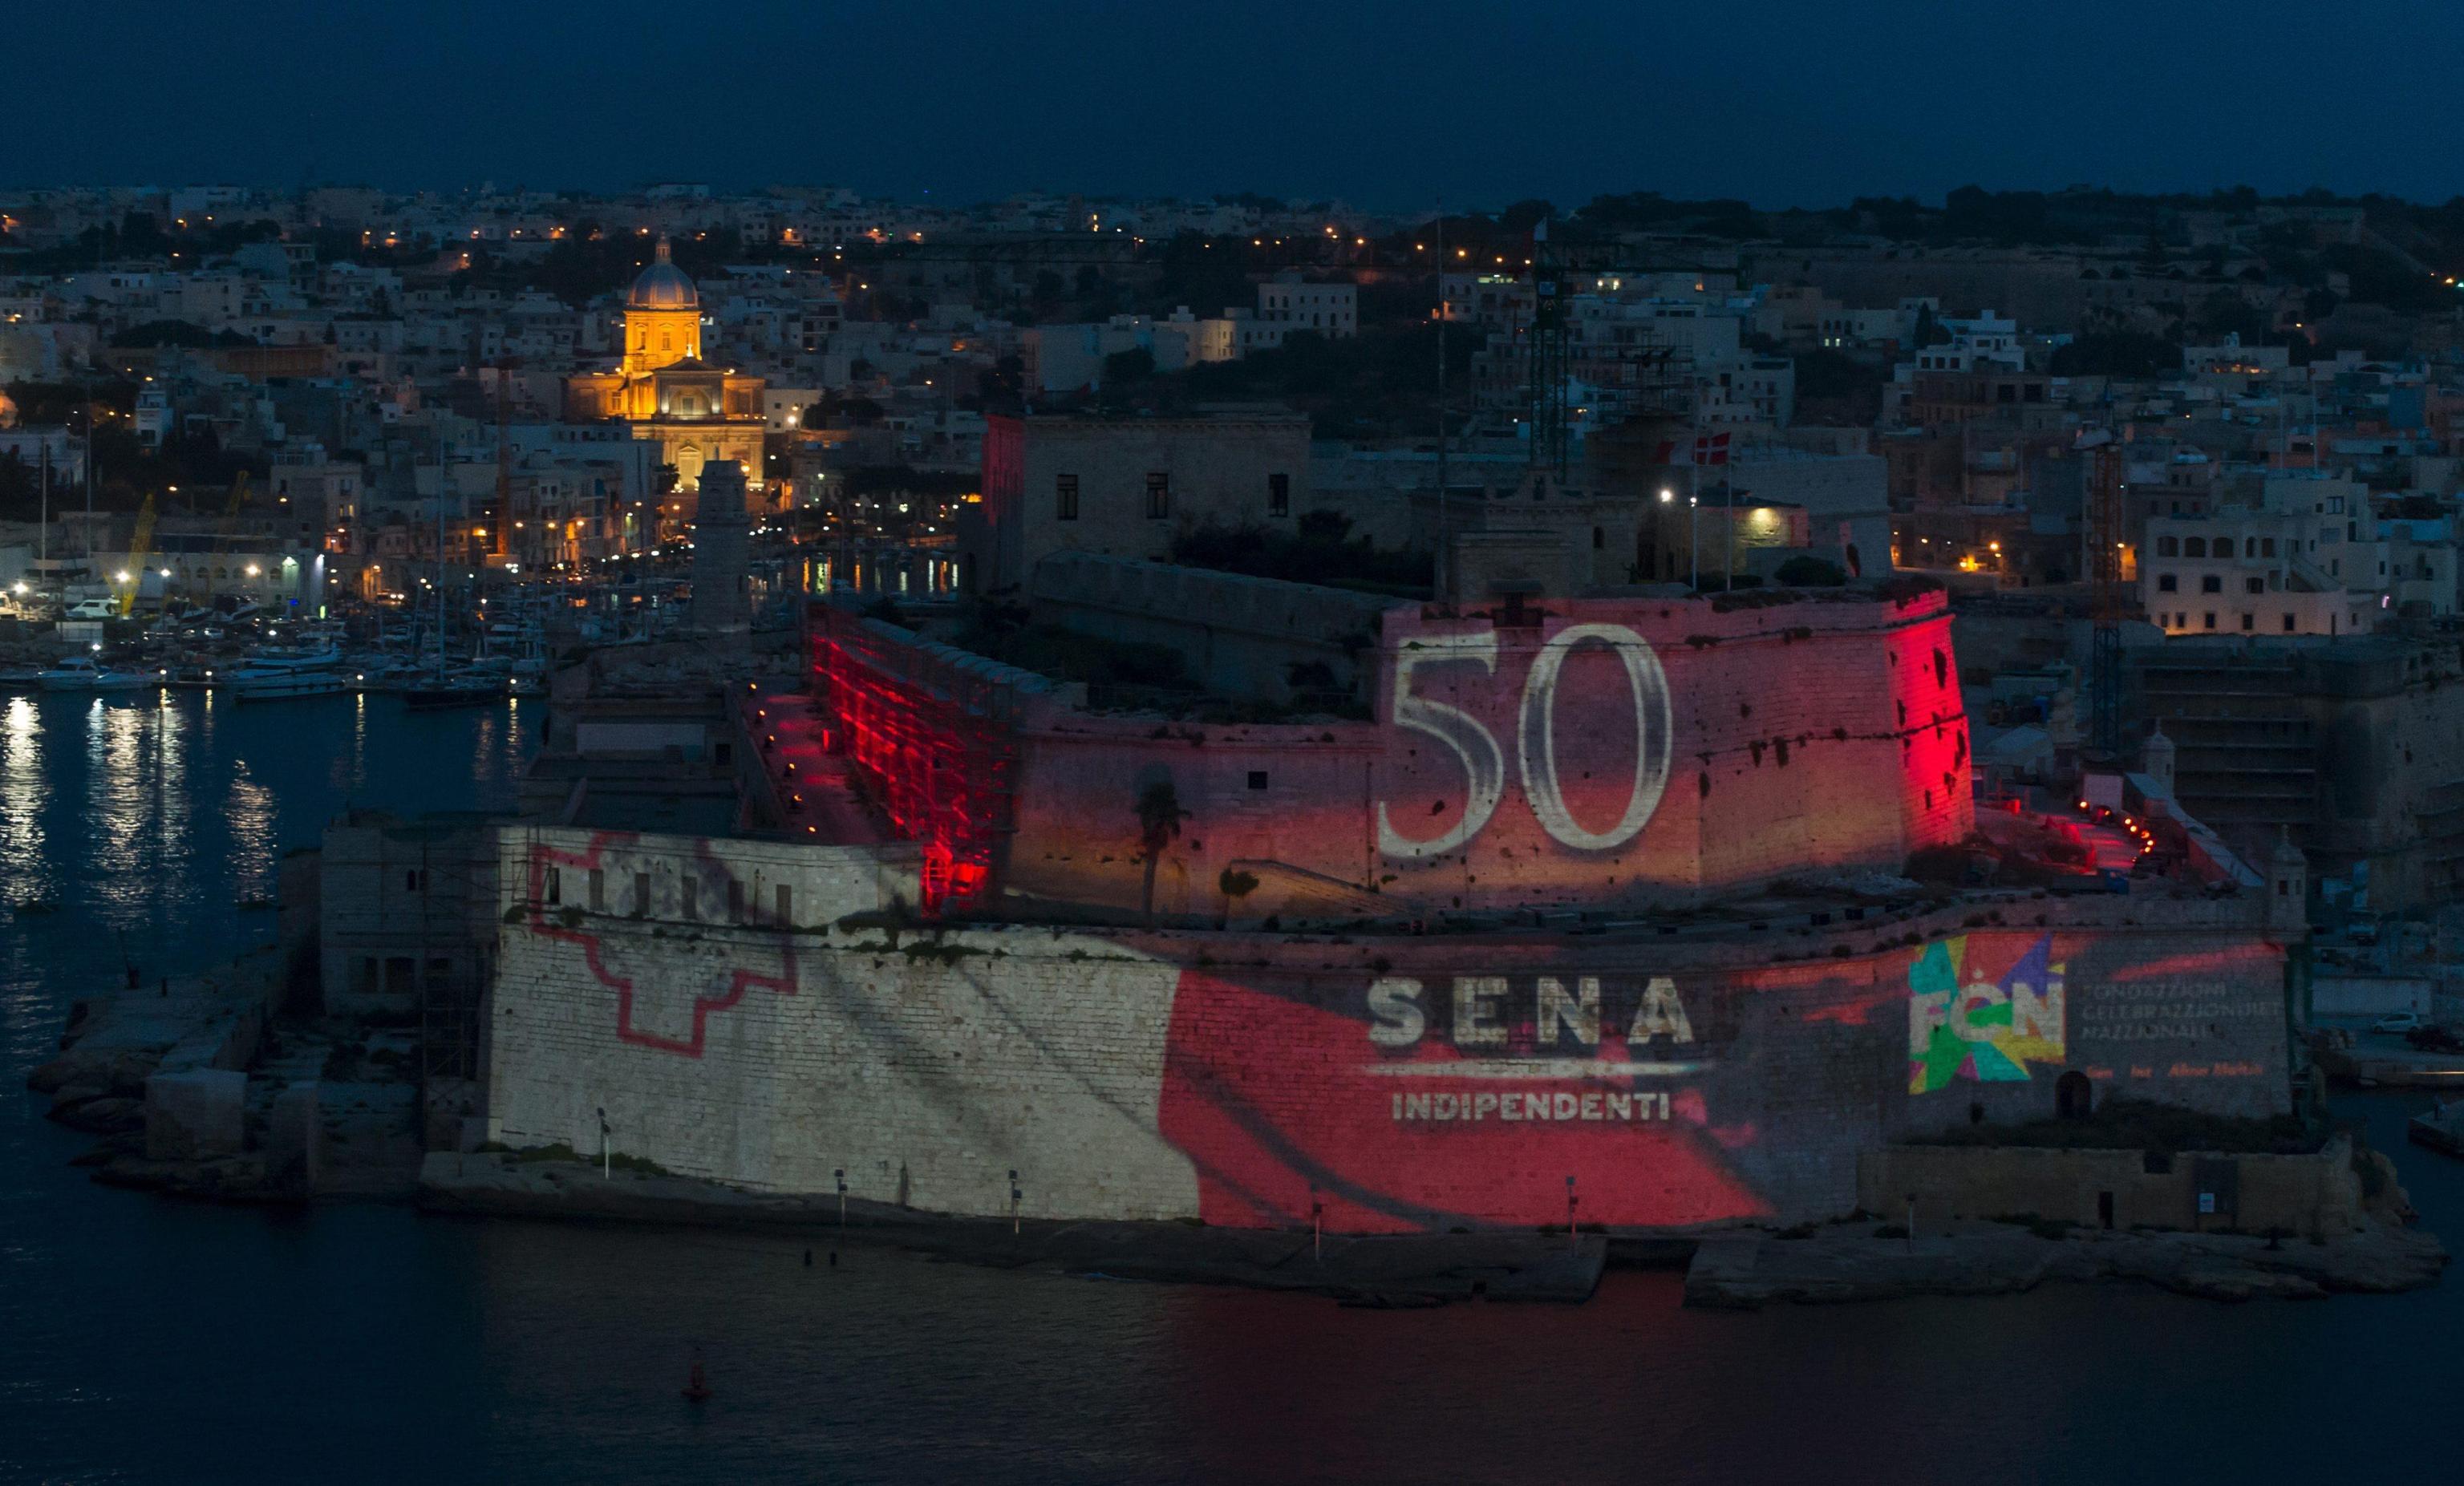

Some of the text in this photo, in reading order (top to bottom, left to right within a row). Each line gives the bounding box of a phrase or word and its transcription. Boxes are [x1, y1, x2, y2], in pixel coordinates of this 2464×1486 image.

[1378, 623, 1673, 857] 50
[1368, 975, 1695, 1046] SENA
[1392, 1092, 1670, 1121] INDIPENDENTI
